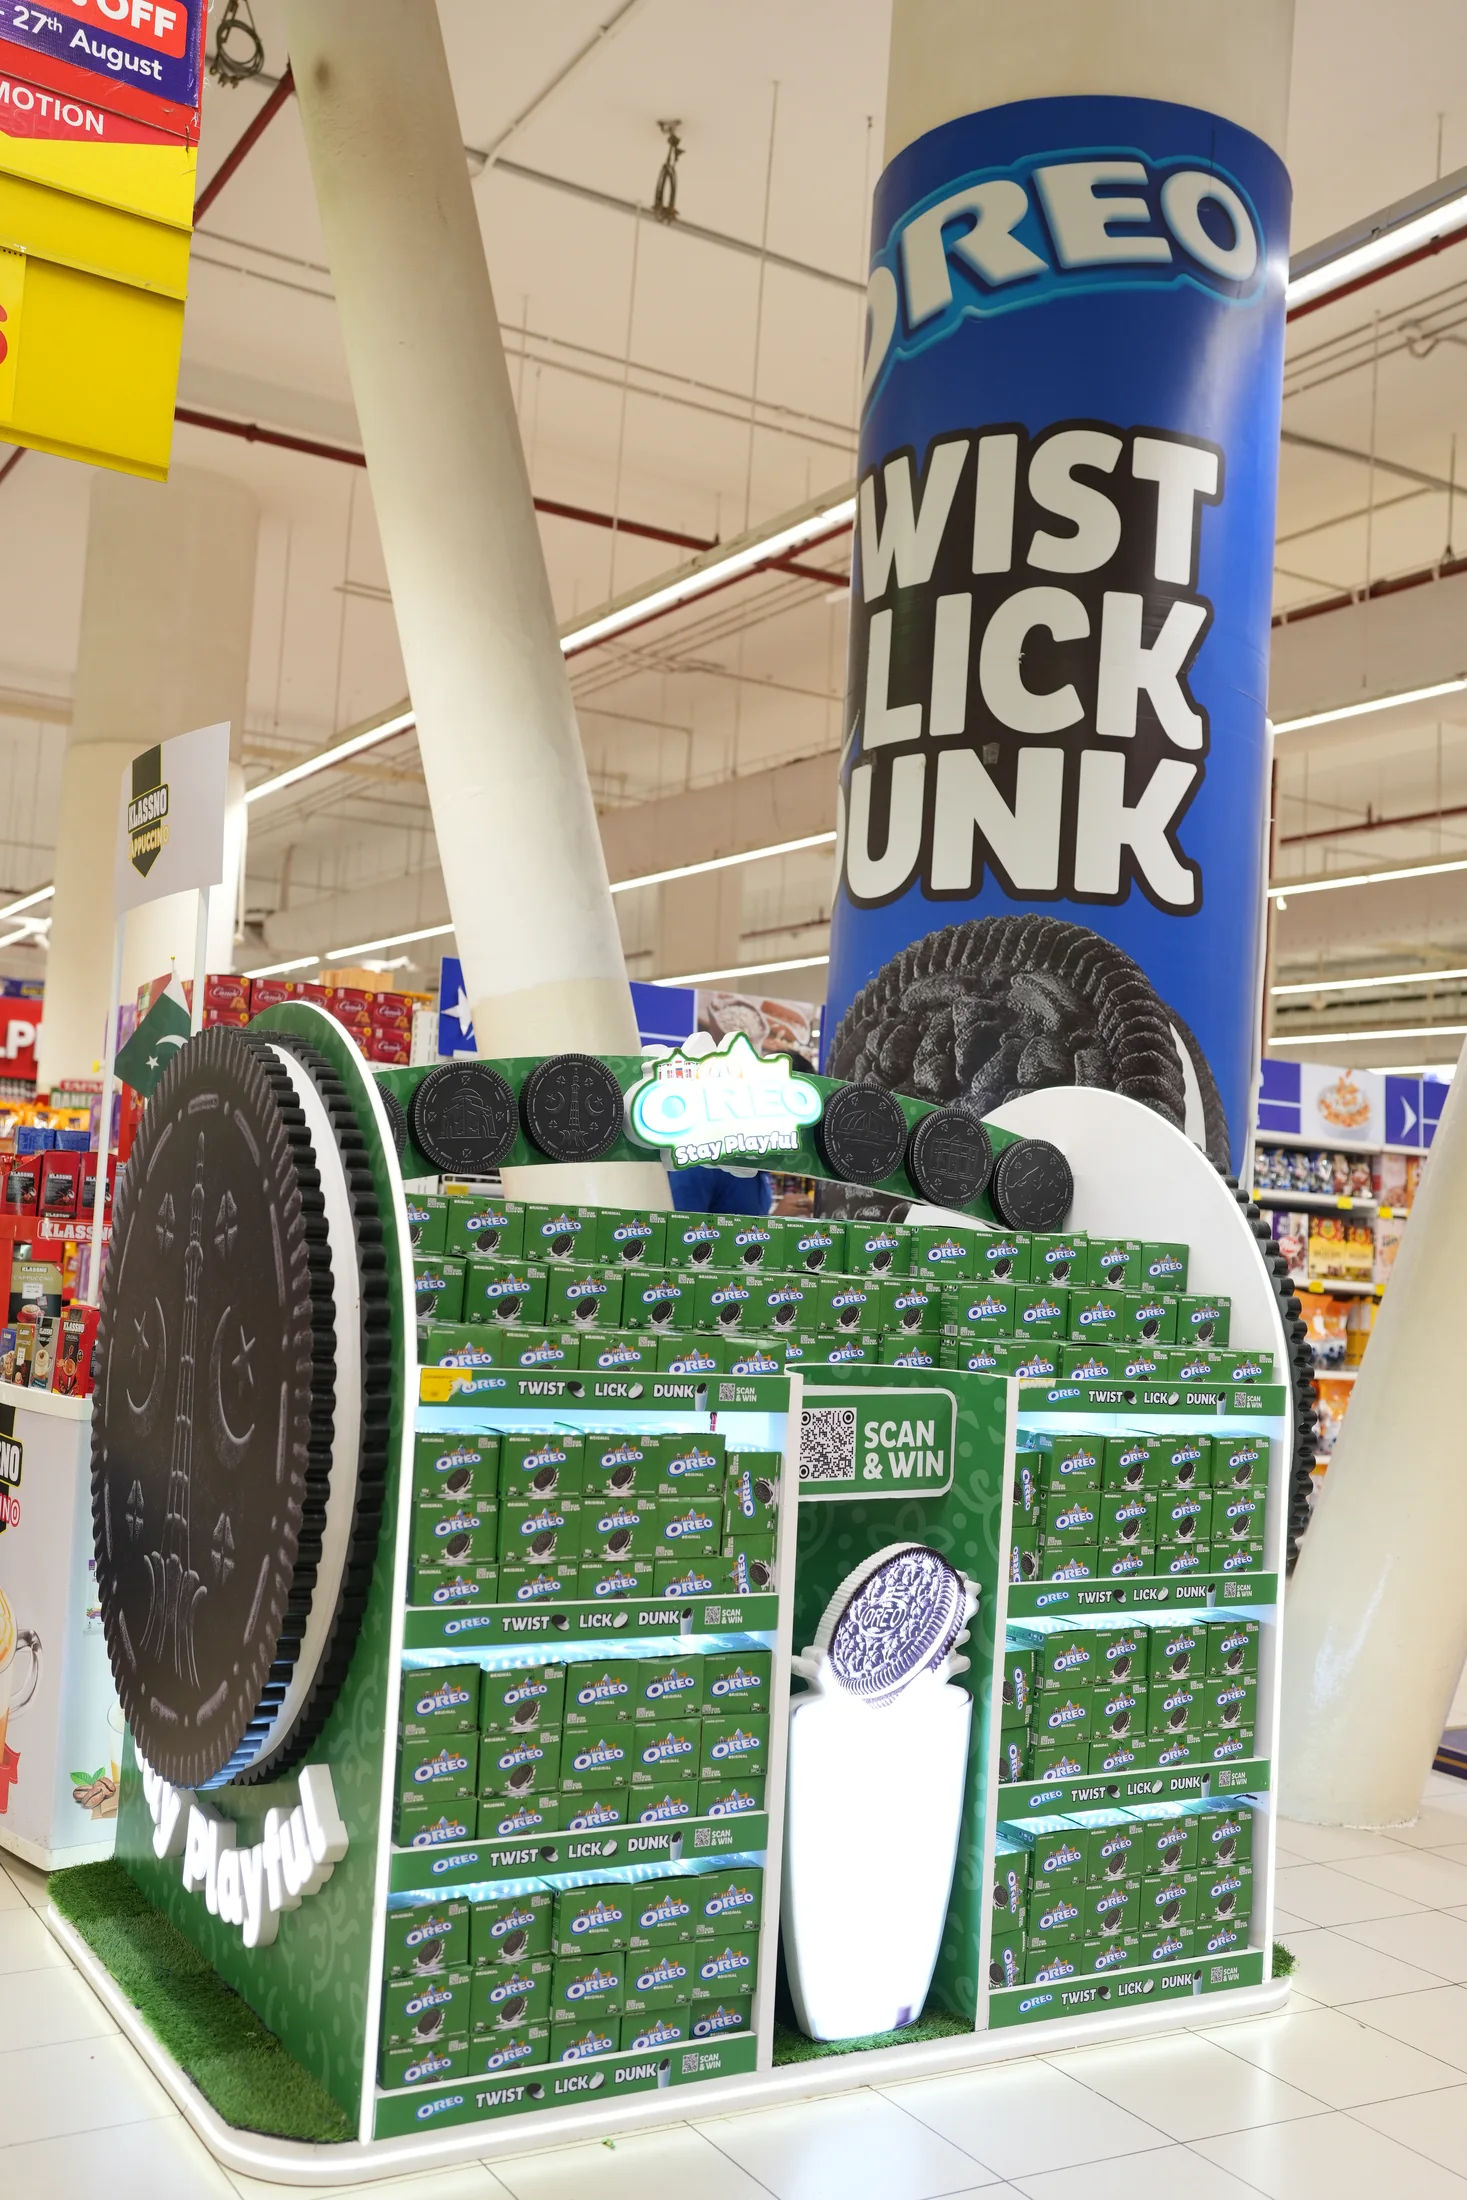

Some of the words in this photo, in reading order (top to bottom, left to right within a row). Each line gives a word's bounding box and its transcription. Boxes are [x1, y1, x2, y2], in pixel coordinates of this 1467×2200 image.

[96, 0, 177, 37] OFF
[69, 29, 162, 81] August
[859, 429, 1219, 604] WIST
[863, 586, 1207, 751] LICK
[129, 788, 167, 830] KLASSNO
[838, 747, 1198, 906] UNK
[638, 1079, 820, 1135] OREO
[675, 1142, 722, 1165] Stay
[725, 1131, 799, 1156] Playful
[467, 1218, 508, 1230] OREO
[541, 1222, 581, 1236] OREO
[614, 1228, 652, 1241] OREO
[683, 1230, 720, 1243] OREO
[735, 1232, 770, 1245] OREO
[797, 1238, 832, 1251] OREO
[928, 1247, 966, 1261] OREO
[986, 1247, 1018, 1259] OREO
[1045, 1250, 1076, 1262] OREO
[1101, 1254, 1129, 1266] OREO
[1149, 1263, 1182, 1276] OREO
[487, 1283, 530, 1298] OREO
[566, 1284, 607, 1298] OREO
[643, 1289, 681, 1303] OREO
[711, 1291, 749, 1304] OREO
[767, 1292, 803, 1305] OREO
[832, 1294, 866, 1308] OREO
[968, 1304, 1006, 1320] OREO
[1079, 1310, 1115, 1325] OREO
[1136, 1308, 1165, 1320] OREO
[1192, 1311, 1219, 1323] OREO
[520, 1351, 564, 1365] OREO
[598, 1352, 640, 1366] OREO
[1125, 1363, 1156, 1376] OREO
[1233, 1367, 1261, 1380] OREO
[460, 1378, 506, 1394] OREO
[518, 1382, 565, 1395] TWIST
[595, 1383, 627, 1396] LICK
[654, 1384, 694, 1397] DUNK
[1047, 1389, 1080, 1402] OREO
[1089, 1391, 1122, 1402] TWIST
[1144, 1393, 1167, 1404] LICK
[1186, 1393, 1216, 1404] DUNK
[864, 1420, 935, 1449] SCAN
[436, 1453, 481, 1470] OREO
[522, 1452, 566, 1469] OREO
[601, 1452, 643, 1467] OREO
[668, 1457, 716, 1475] OREO
[863, 1452, 883, 1480] &
[888, 1450, 944, 1478] WIN
[1060, 1458, 1096, 1474] OREO
[1120, 1452, 1149, 1466] OREO
[1229, 1452, 1258, 1467] OREO
[744, 1471, 755, 1517] OREO
[521, 1517, 564, 1534] OREO
[1036, 1592, 1069, 1607] OREO
[1078, 1591, 1111, 1603] TWIST
[1133, 1589, 1157, 1601] LICK
[1176, 1587, 1205, 1598] DUNK
[444, 1617, 489, 1634] OREO
[503, 1616, 549, 1631] TWIST
[579, 1613, 612, 1628] LICK
[639, 1611, 680, 1625] DUNK
[729, 1616, 743, 1624] WIN
[863, 1607, 902, 1628] OREO
[1166, 1641, 1195, 1656] OREO
[1053, 1653, 1089, 1671] OREO
[504, 1685, 547, 1704] OREO
[578, 1684, 628, 1704] OREO
[711, 1677, 761, 1696] OREO
[416, 1692, 469, 1715] OREO
[1217, 1690, 1246, 1706] OREO
[642, 1743, 692, 1763] OREO
[1072, 1787, 1106, 1801] TWIST
[1128, 1783, 1151, 1795] LICK
[1170, 1778, 1200, 1790] DUNK
[1029, 1791, 1062, 1808] OREO
[712, 1830, 730, 1838] SCAN
[183, 1764, 340, 1948] Playful
[491, 1849, 538, 1866] TWIST
[569, 1843, 602, 1857] LICK
[628, 1836, 669, 1852] DUNK
[1101, 1840, 1131, 1857] OREO
[432, 1854, 478, 1873] OREO
[1043, 1852, 1081, 1872] OREO
[1211, 1881, 1241, 1897] OREO
[705, 1894, 753, 1915] OREO
[571, 1910, 622, 1934] OREO
[406, 1922, 451, 1946] OREO
[636, 1968, 686, 1990] OREO
[490, 1981, 535, 2002] OREO
[1062, 1990, 1096, 2005] TWIST
[1118, 1983, 1142, 1996] LICK
[1162, 1977, 1191, 1989] DUNK
[1019, 1995, 1052, 2013] OREO
[700, 2053, 719, 2063] SCAN
[706, 2061, 721, 2070] WIN
[476, 2087, 524, 2107] TWIST
[555, 2074, 588, 2094] LICK
[615, 2063, 656, 2083] DUNK
[417, 2096, 463, 2119] OREO
